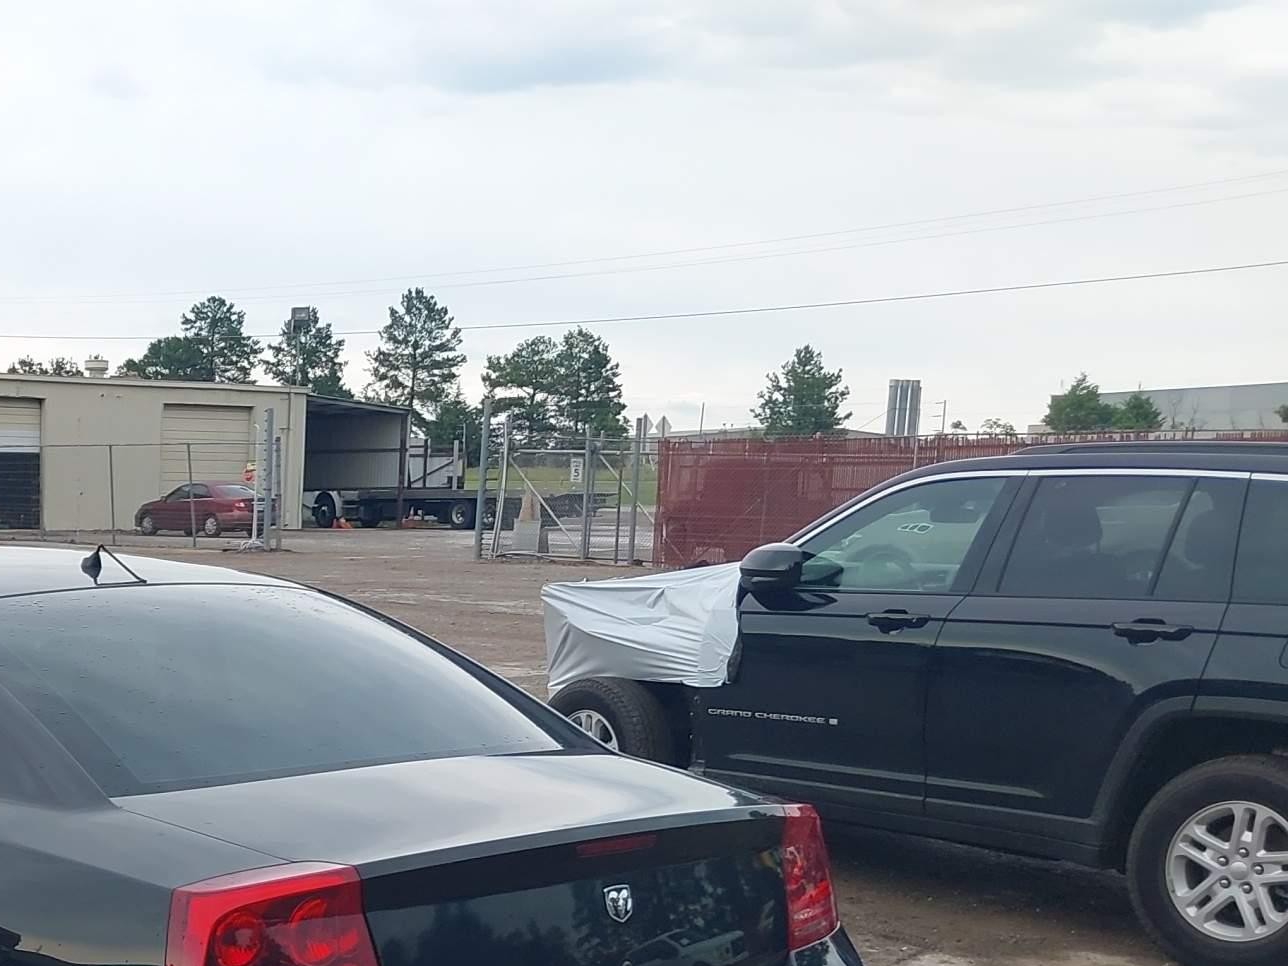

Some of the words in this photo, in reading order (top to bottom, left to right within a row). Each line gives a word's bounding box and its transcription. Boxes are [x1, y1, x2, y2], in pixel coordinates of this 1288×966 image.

[573, 468, 580, 477] 5
[708, 708, 752, 717] GRAND
[755, 712, 825, 724] CHEROKEE
